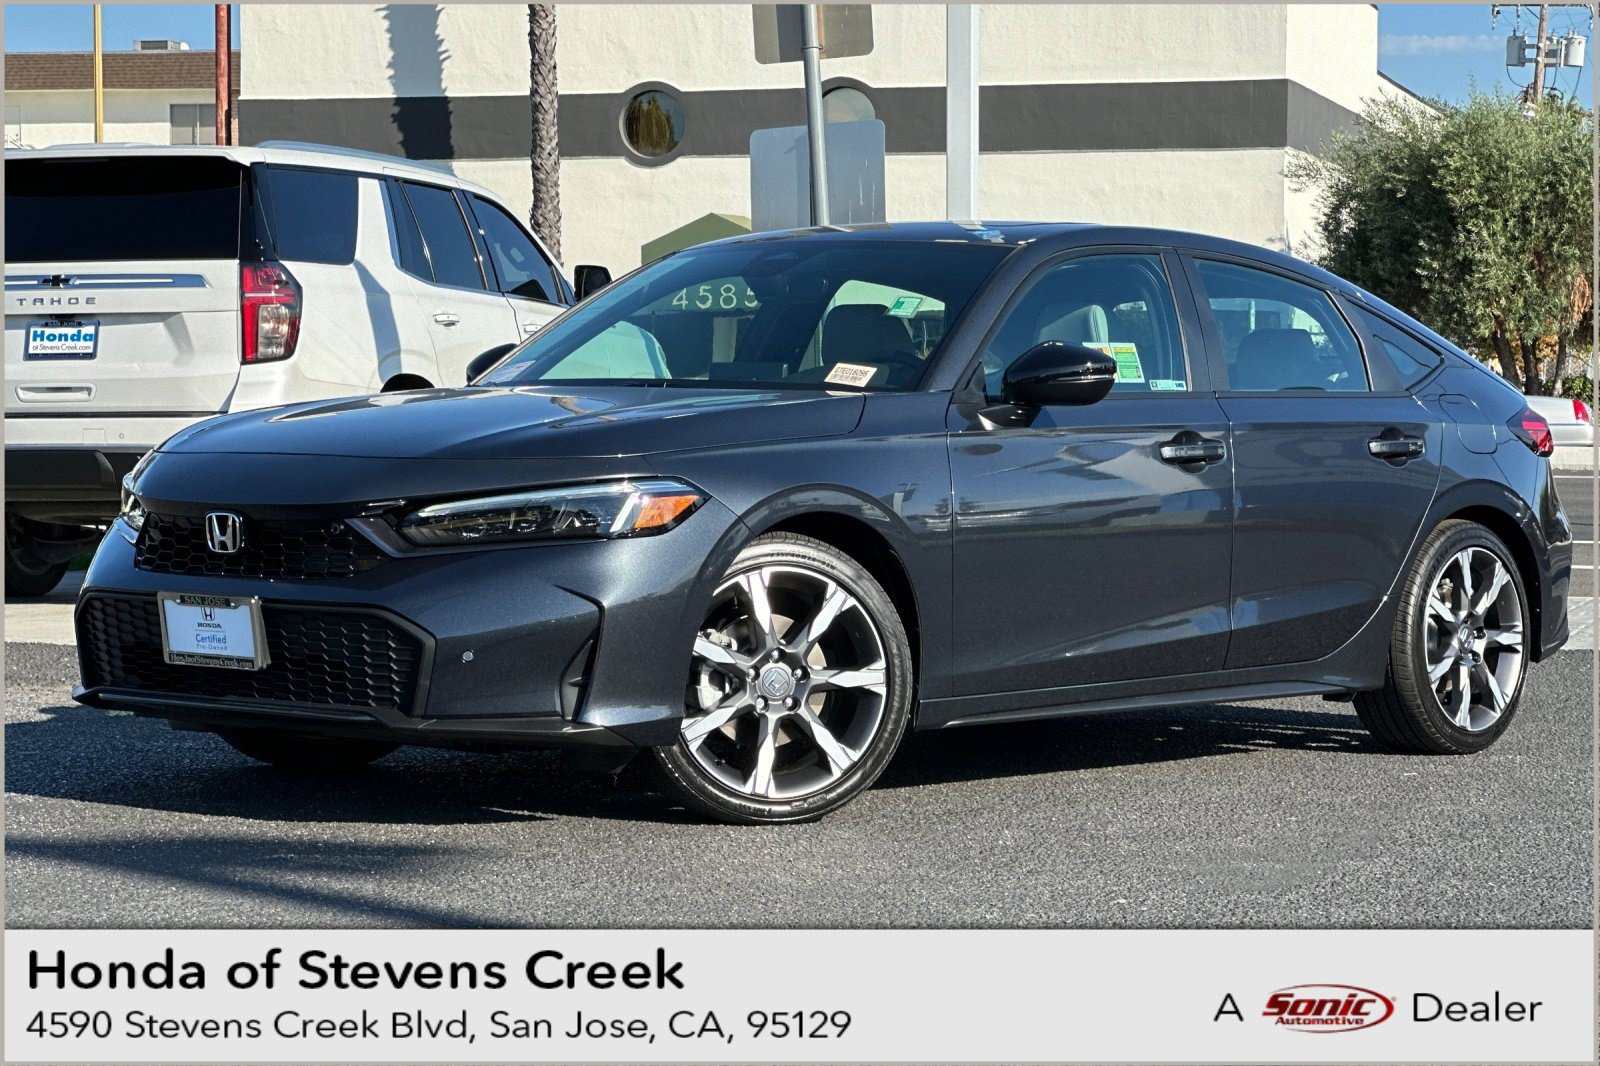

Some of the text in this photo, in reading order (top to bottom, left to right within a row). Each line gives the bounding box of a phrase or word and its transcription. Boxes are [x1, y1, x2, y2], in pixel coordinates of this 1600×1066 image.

[16, 297, 96, 306] TAHOE
[32, 329, 95, 342] Honda
[184, 596, 226, 606] SAN JOSE
[195, 633, 227, 644] Certified
